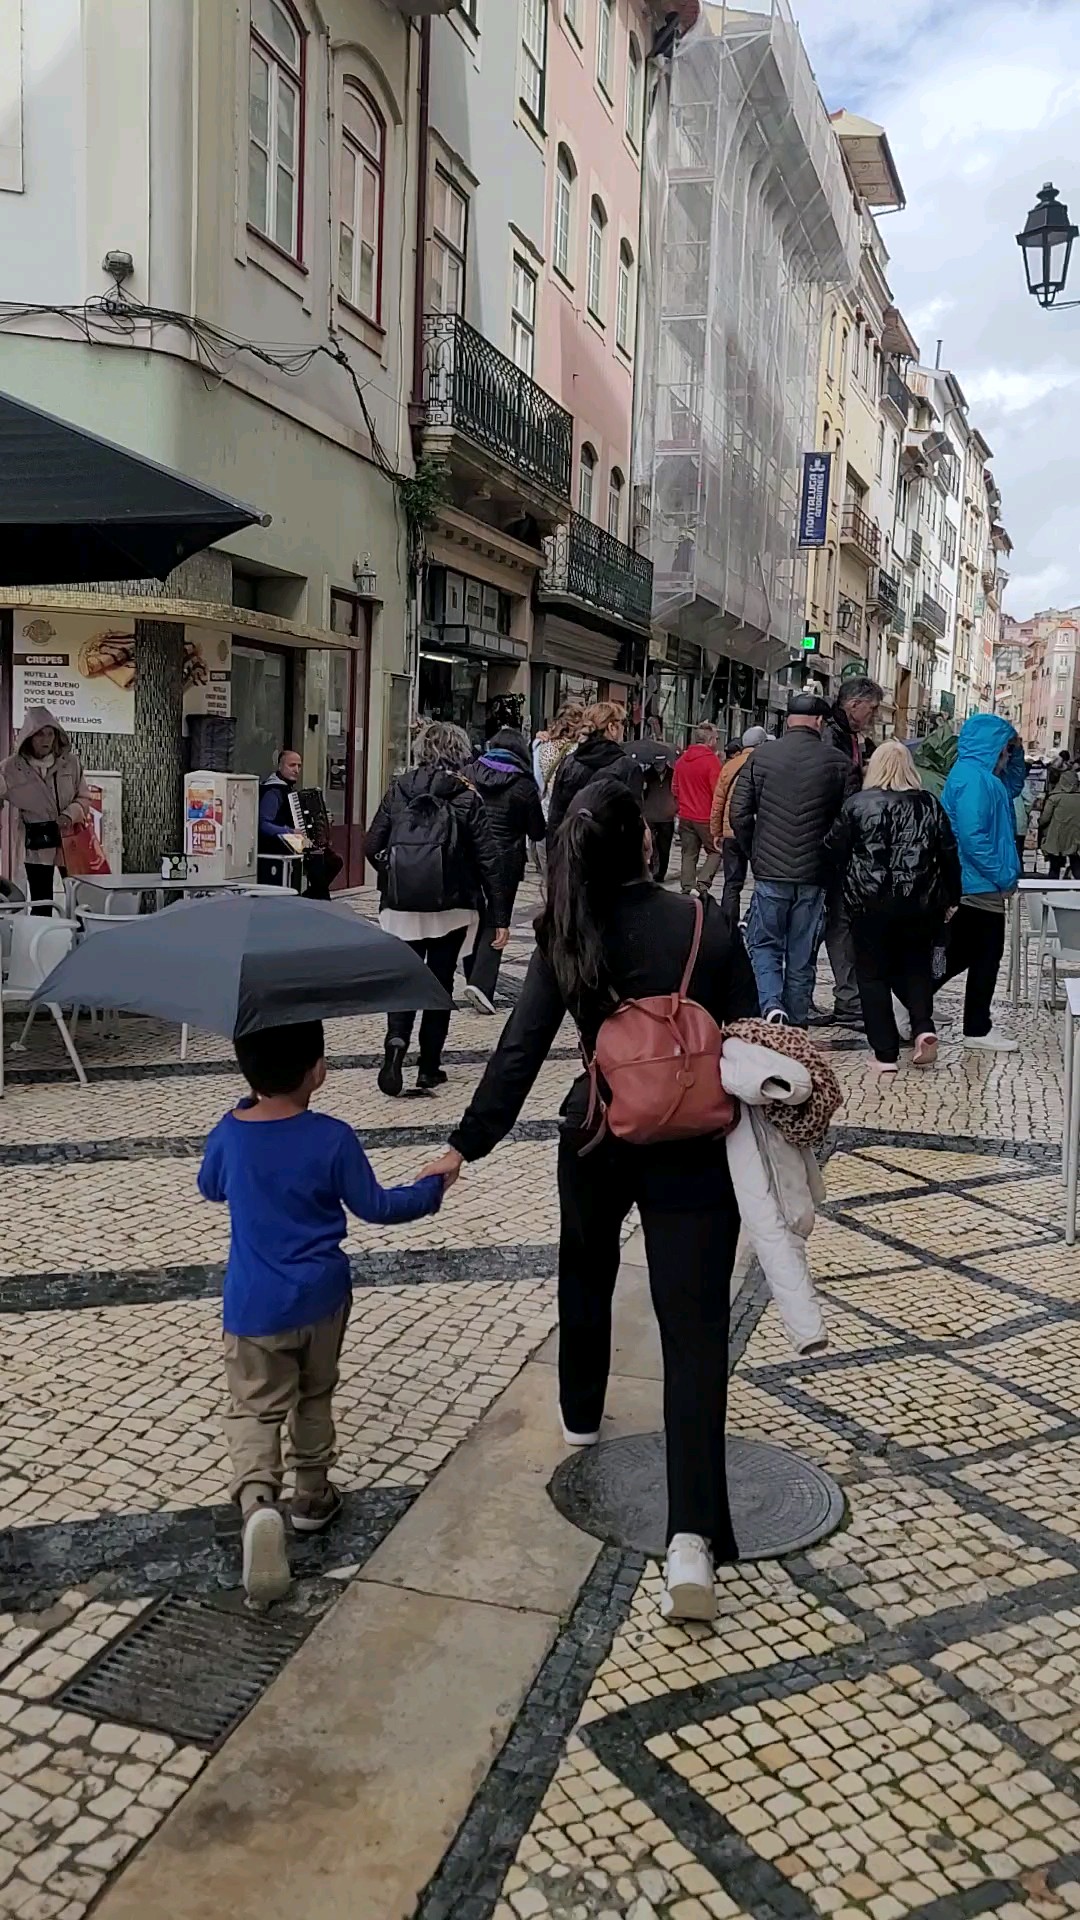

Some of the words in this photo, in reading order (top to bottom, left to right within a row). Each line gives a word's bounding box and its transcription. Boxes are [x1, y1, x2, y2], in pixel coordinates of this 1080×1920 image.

[805, 474, 817, 537] MONTALUGA
[26, 656, 63, 664] CREPES
[24, 671, 58, 679] NUTELLA
[54, 681, 80, 689] BUENO
[55, 716, 102, 724] VERMELHOS
